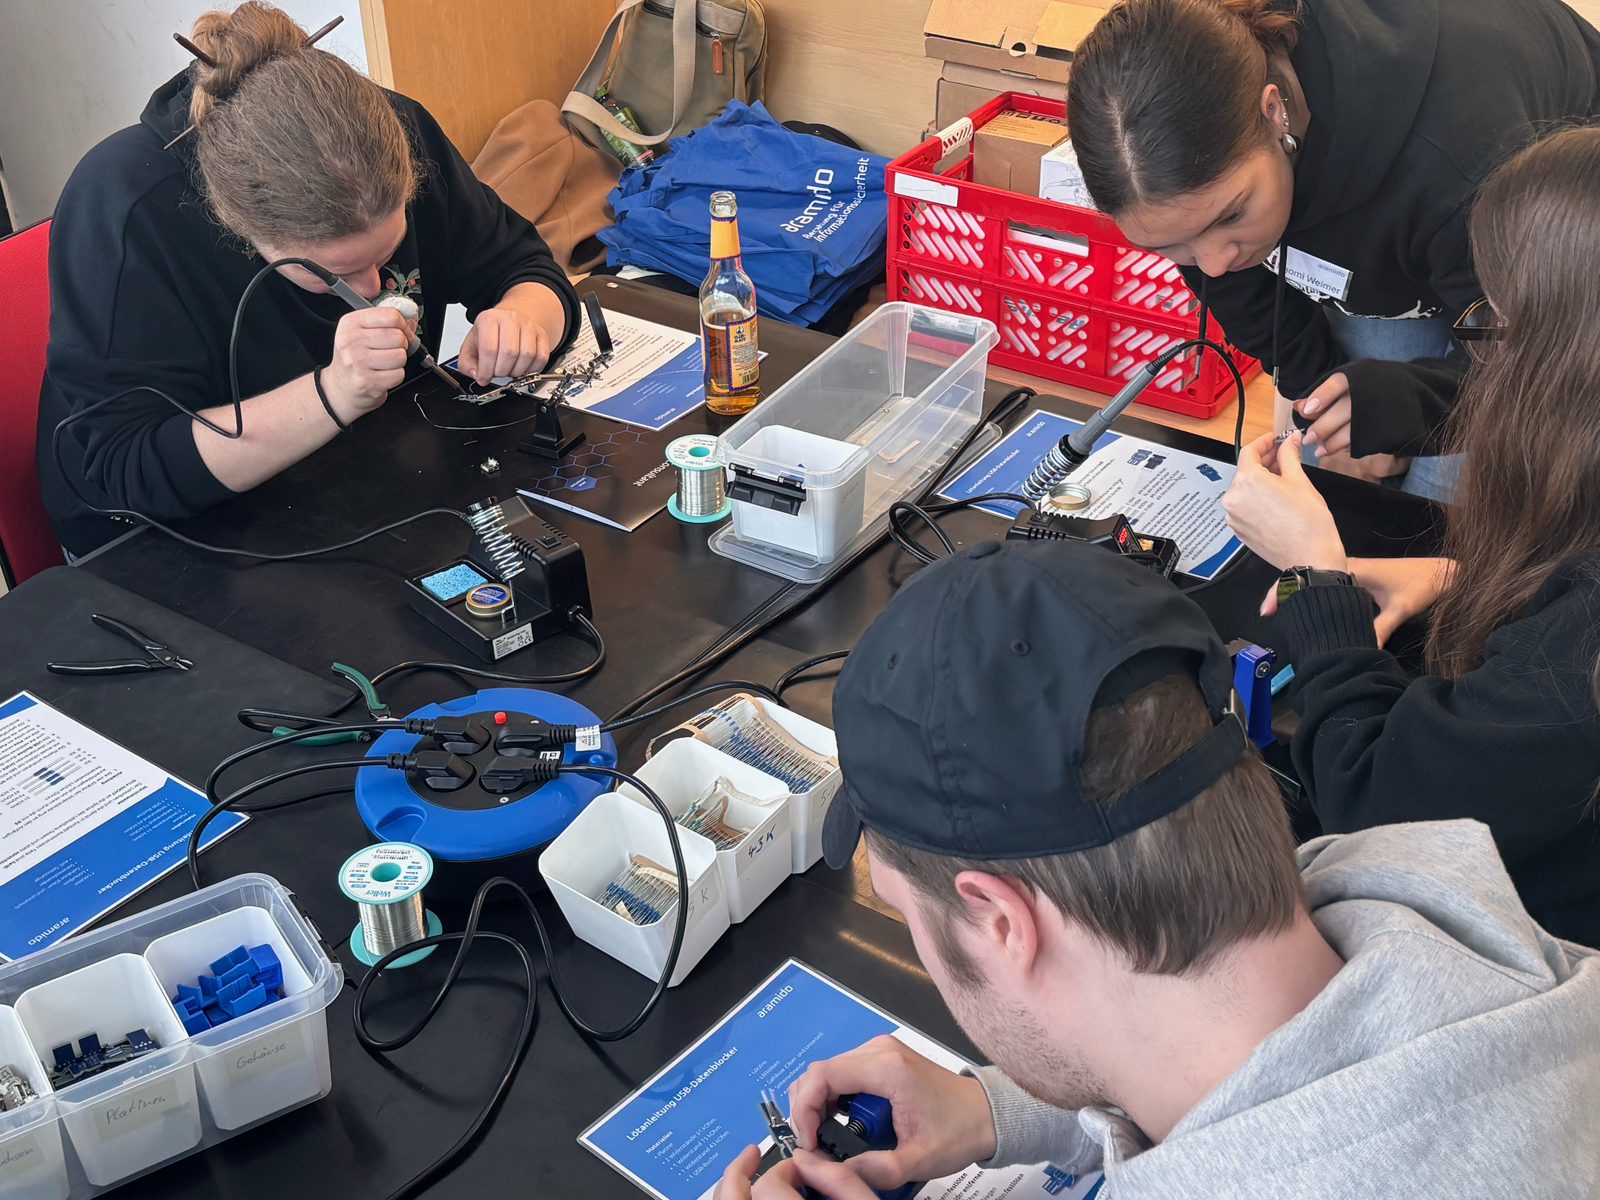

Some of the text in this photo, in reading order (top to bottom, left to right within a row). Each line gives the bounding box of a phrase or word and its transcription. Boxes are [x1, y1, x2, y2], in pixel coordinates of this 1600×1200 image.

[1317, 263, 1346, 278] aramido
[1306, 275, 1342, 295] Weimer
[97, 850, 164, 893] USB-Datenblocker
[365, 889, 390, 897] Weller
[27, 917, 69, 945] aramido
[757, 985, 793, 1017] aramido
[236, 1043, 285, 1069] Gehäuse
[626, 1046, 737, 1140] Lötanleitung USB-Datenblocker
[106, 1096, 165, 1124] Platinen
[645, 1131, 673, 1153] Materialien
[656, 1142, 673, 1156] Platine
[668, 1134, 696, 1158] Widerstände
[700, 1117, 716, 1130] kOhm
[677, 1141, 702, 1164] Widerstand
[706, 1125, 721, 1137] kOhm
[684, 1146, 710, 1169] Widerstand
[714, 1130, 729, 1143] kOhm
